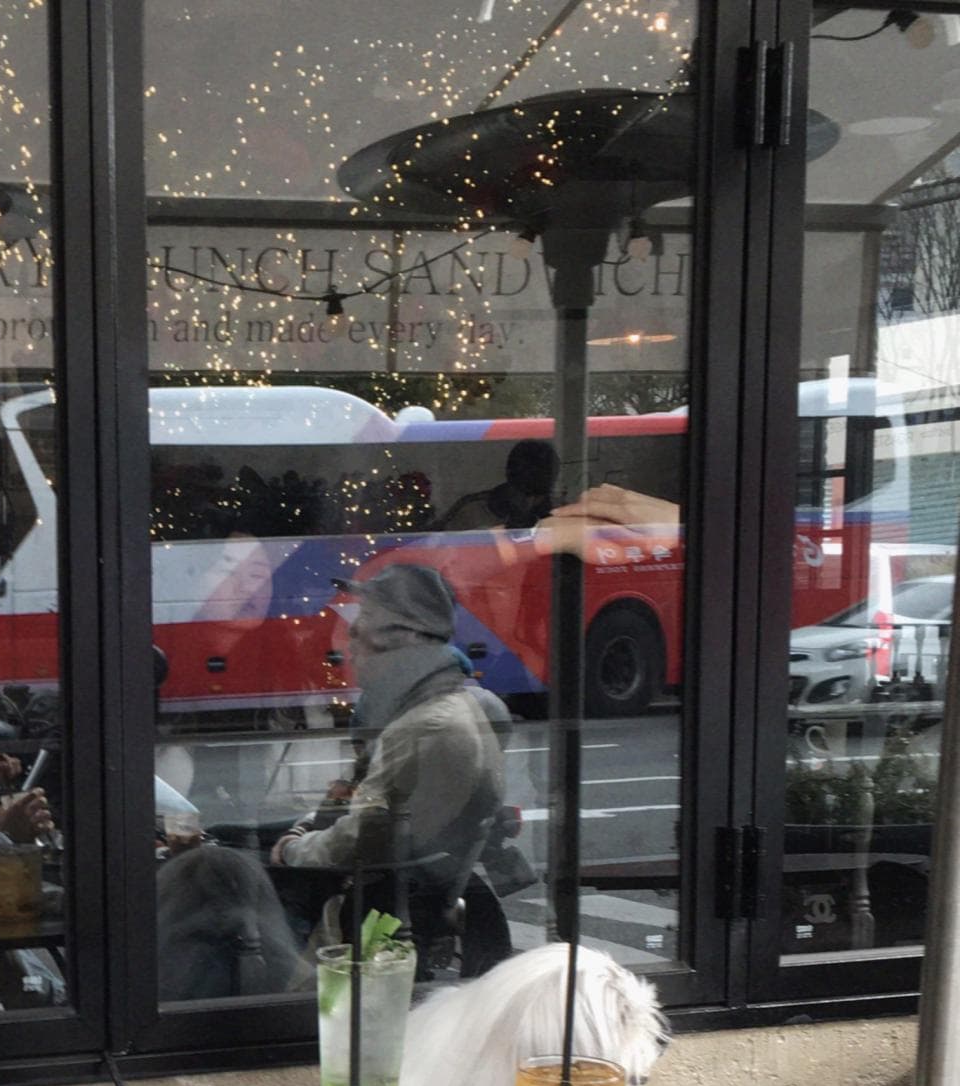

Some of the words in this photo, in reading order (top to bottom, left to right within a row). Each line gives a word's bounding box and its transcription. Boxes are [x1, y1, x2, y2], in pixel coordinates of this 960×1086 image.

[364, 247, 691, 297] SANDICH
[173, 310, 233, 343] and
[349, 320, 438, 350] every
